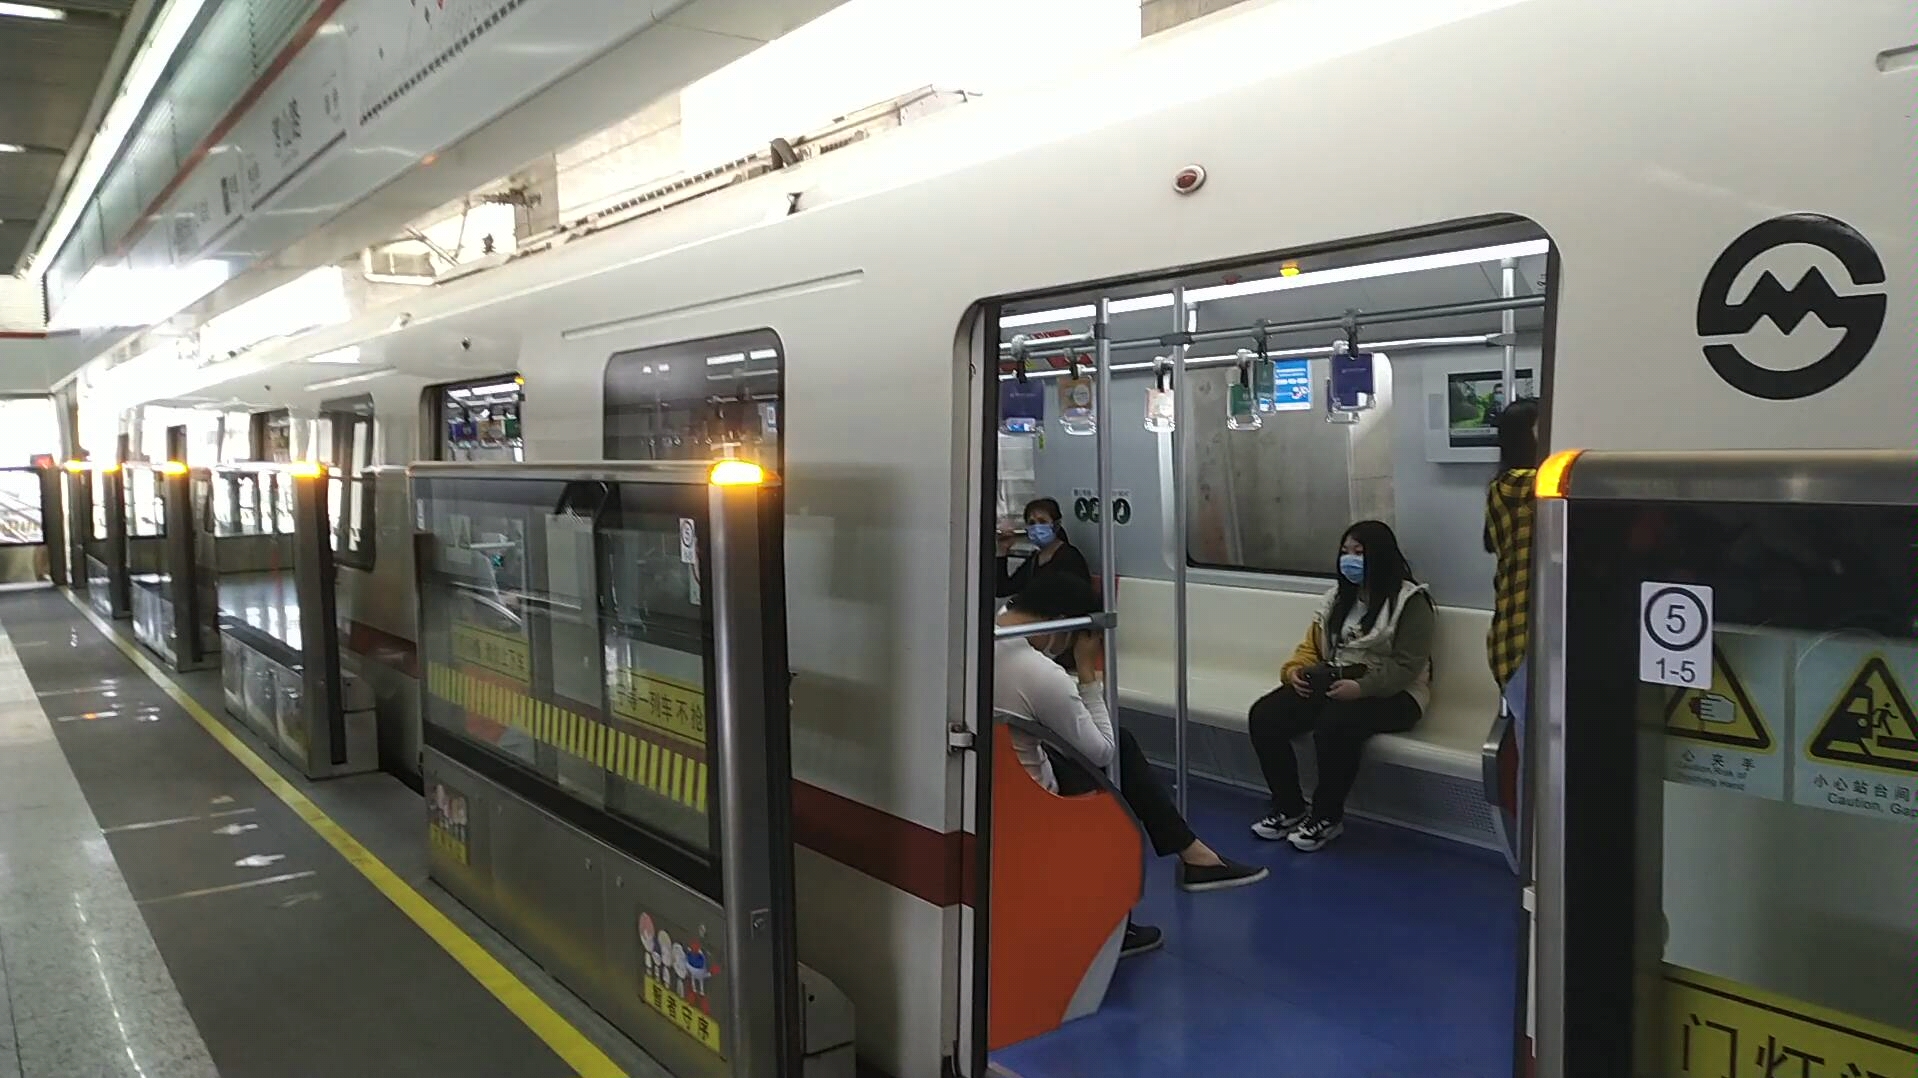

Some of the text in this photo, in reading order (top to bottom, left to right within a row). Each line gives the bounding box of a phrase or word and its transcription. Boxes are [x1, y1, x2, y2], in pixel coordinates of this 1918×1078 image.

[1666, 604, 1687, 635] 5
[1656, 657, 1696, 684] 1-5
[1813, 773, 1918, 803] 小心站台间
[1683, 1013, 1890, 1078] 门灯
